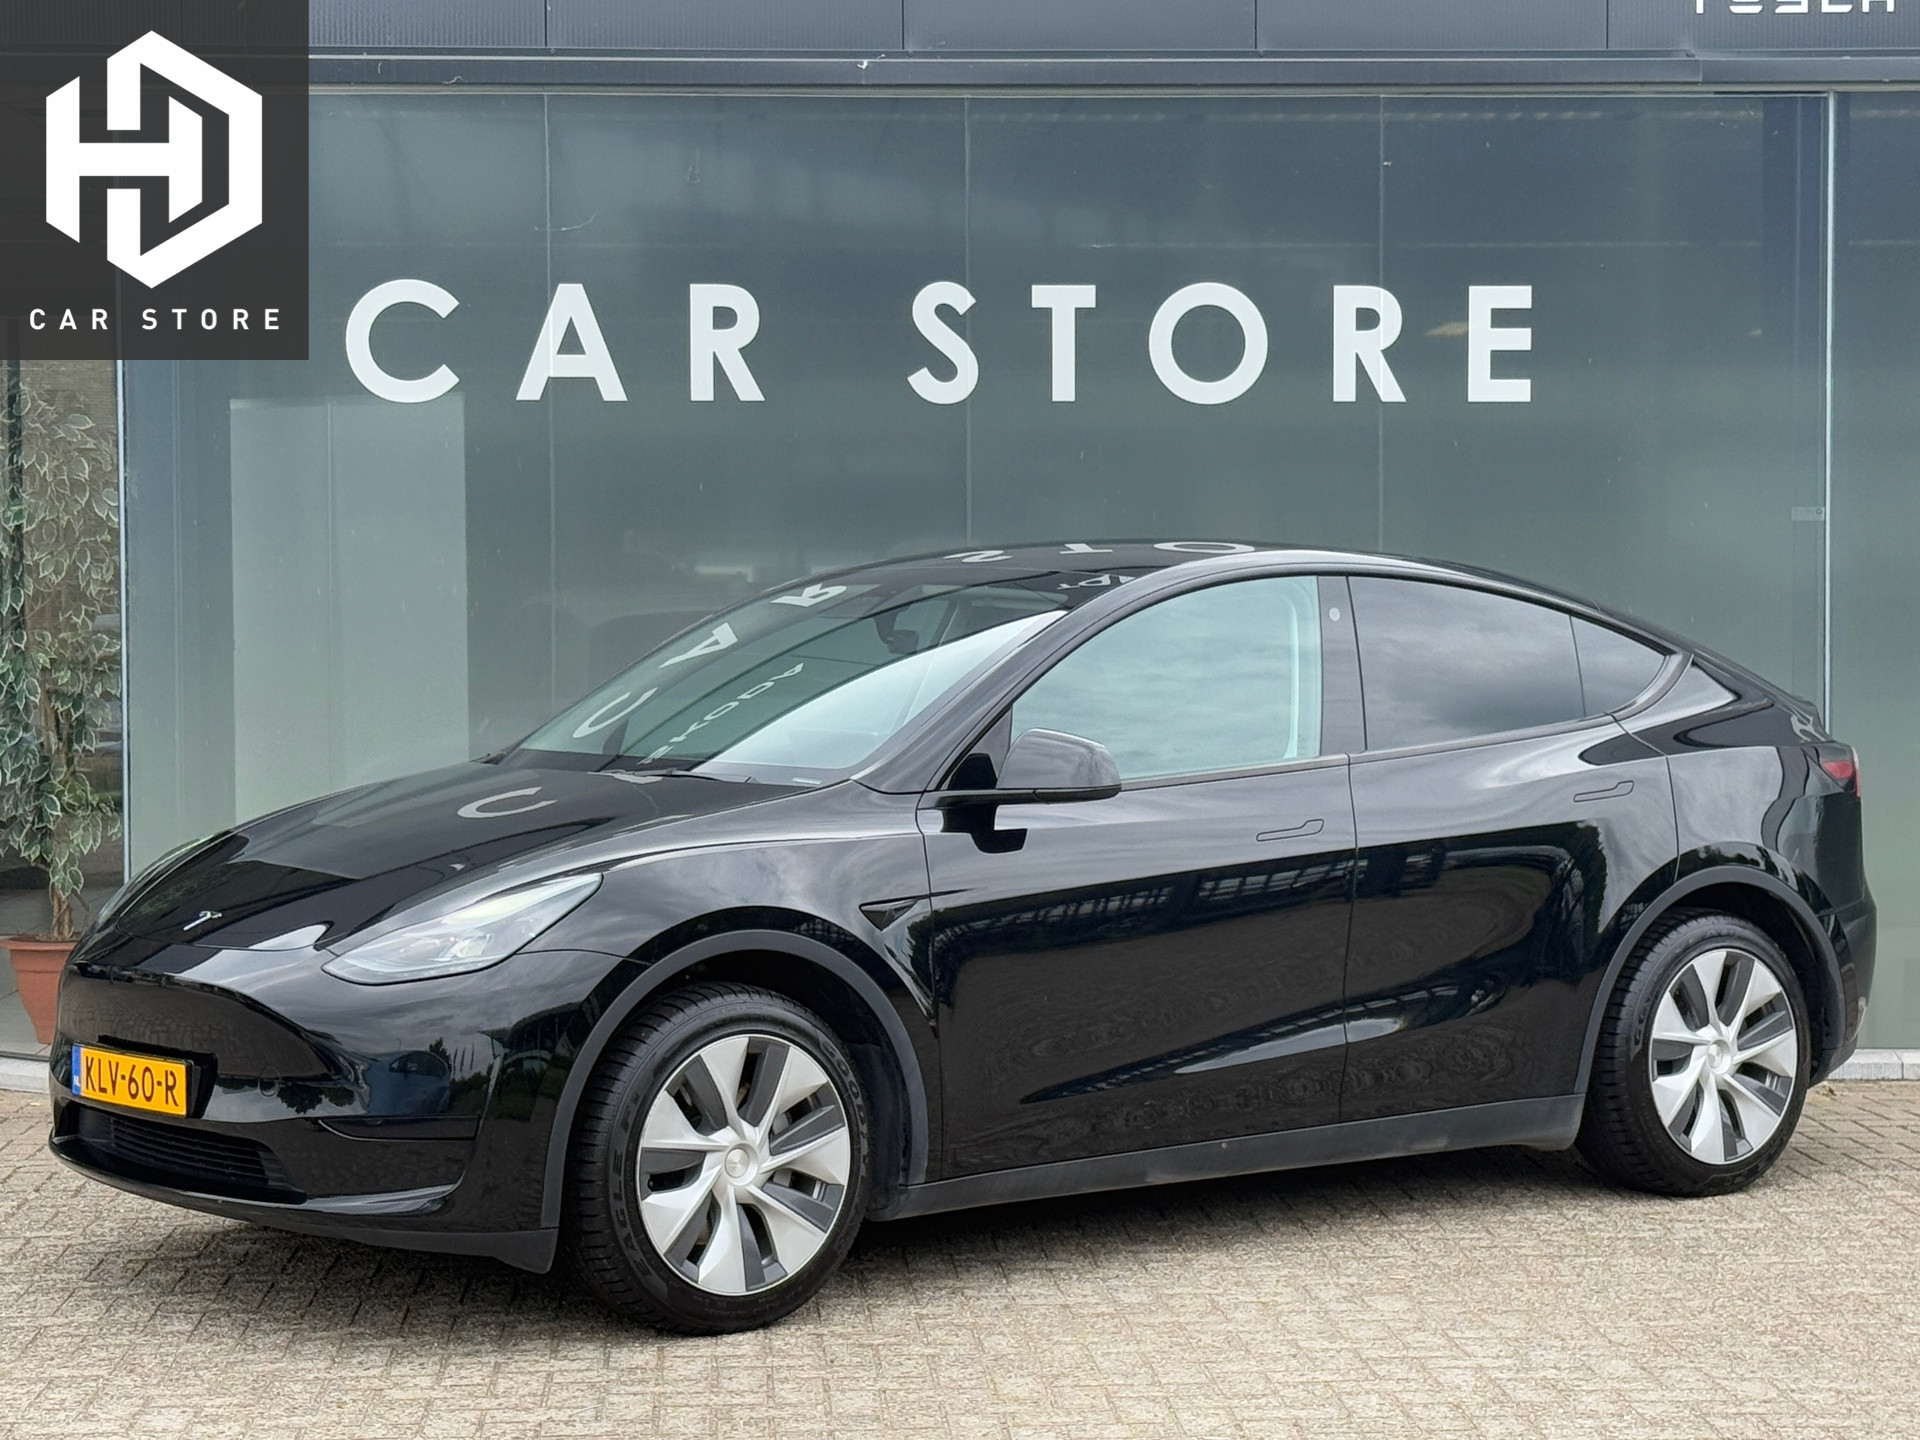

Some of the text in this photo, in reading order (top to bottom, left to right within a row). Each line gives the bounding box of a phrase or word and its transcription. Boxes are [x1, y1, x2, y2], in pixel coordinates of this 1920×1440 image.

[345, 279, 1533, 404] CAR STORE
[85, 1055, 179, 1107] KLV-60-R
